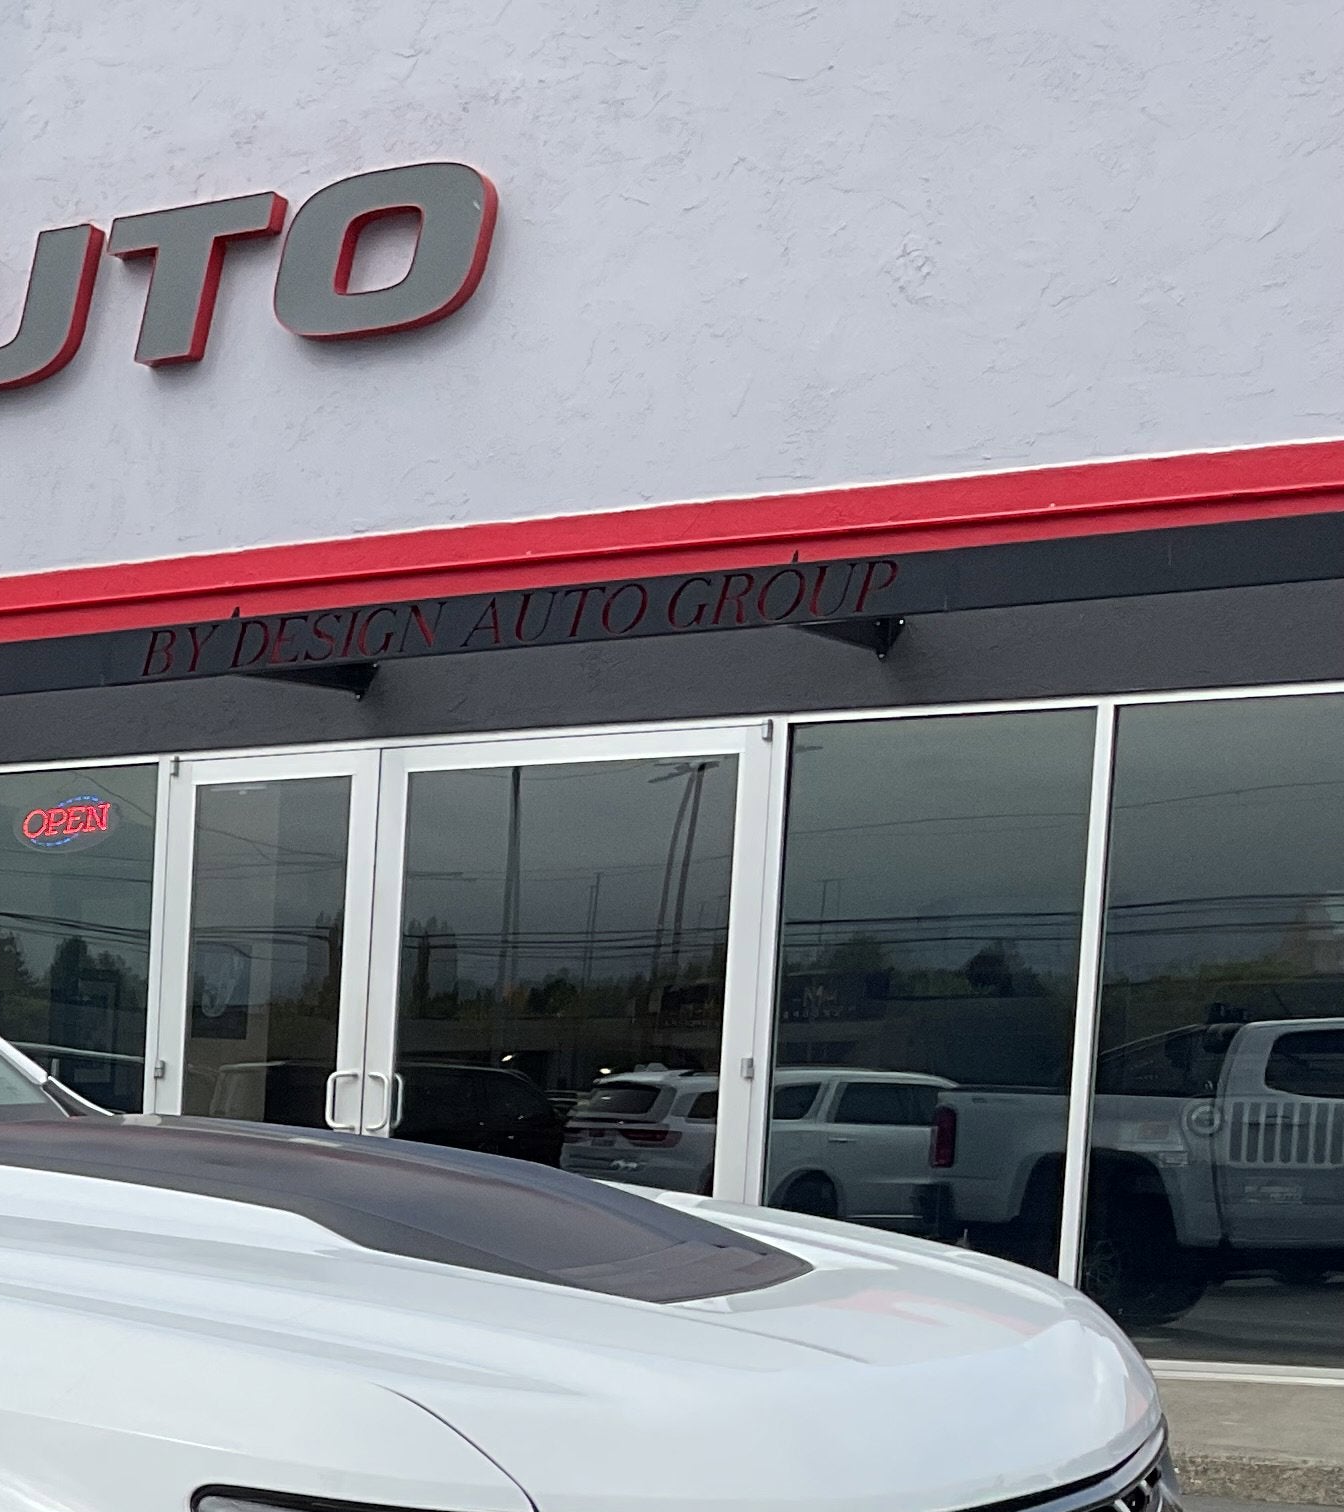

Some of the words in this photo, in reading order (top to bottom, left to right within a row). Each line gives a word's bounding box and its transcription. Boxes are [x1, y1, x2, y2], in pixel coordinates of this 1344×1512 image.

[142, 625, 221, 677] BY
[229, 600, 448, 669] DESIGN
[460, 583, 649, 647] AUTO
[668, 558, 900, 629] GROUP
[22, 802, 111, 839] OPEN
